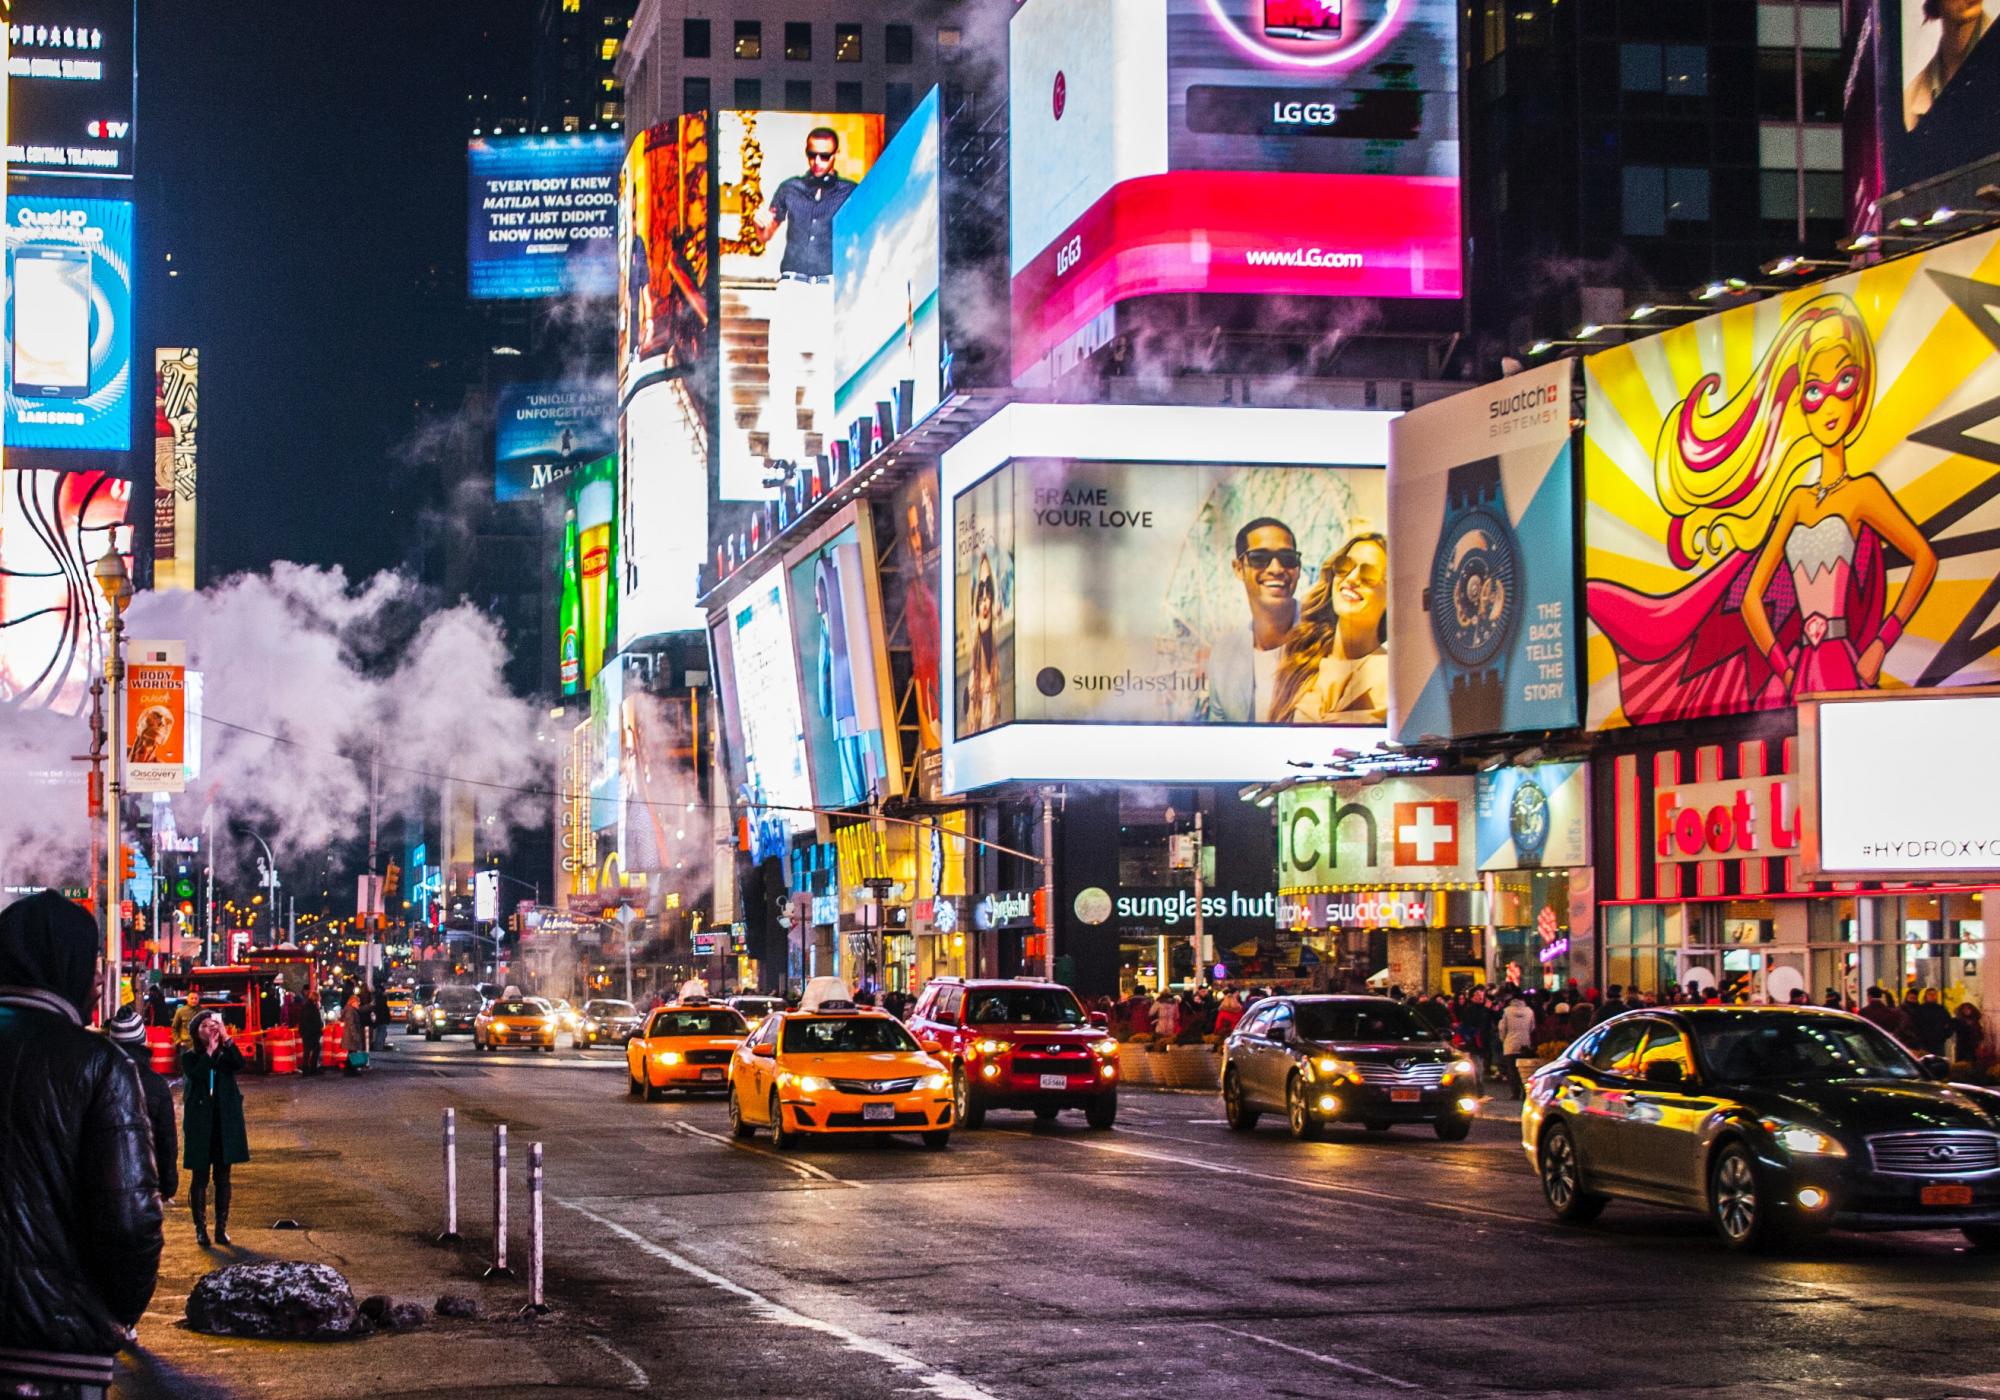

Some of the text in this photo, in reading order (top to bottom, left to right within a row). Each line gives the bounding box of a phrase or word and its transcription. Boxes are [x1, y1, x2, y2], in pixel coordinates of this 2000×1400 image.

[1273, 101, 1336, 124] LG G3
[87, 119, 129, 139] CCTV
[570, 176, 611, 190] KNEW
[482, 193, 618, 210] MATILDA WAS GOOD,
[62, 209, 88, 227] HD
[490, 210, 608, 226] THEY JUST DIDN'T
[488, 228, 531, 242] KNOW
[533, 227, 567, 240] HOW
[1245, 248, 1363, 268] www.LG.com
[1489, 385, 1547, 419] swatch
[1489, 409, 1559, 438] SISTEM51
[1034, 488, 1108, 506] FRAME
[1034, 509, 1153, 528] YOUR LOVE
[1536, 602, 1562, 620] THE
[1529, 623, 1562, 641] BACK
[1526, 642, 1563, 661] TELLS
[139, 671, 173, 680] BODY
[1538, 662, 1563, 680] THE
[131, 680, 183, 689] WORLDS
[1072, 669, 1209, 697] sunglass hut
[1524, 682, 1564, 702] STORY
[1657, 788, 1759, 857] Foot
[1117, 889, 1275, 925] sunglass hut
[1326, 902, 1407, 922] swatch
